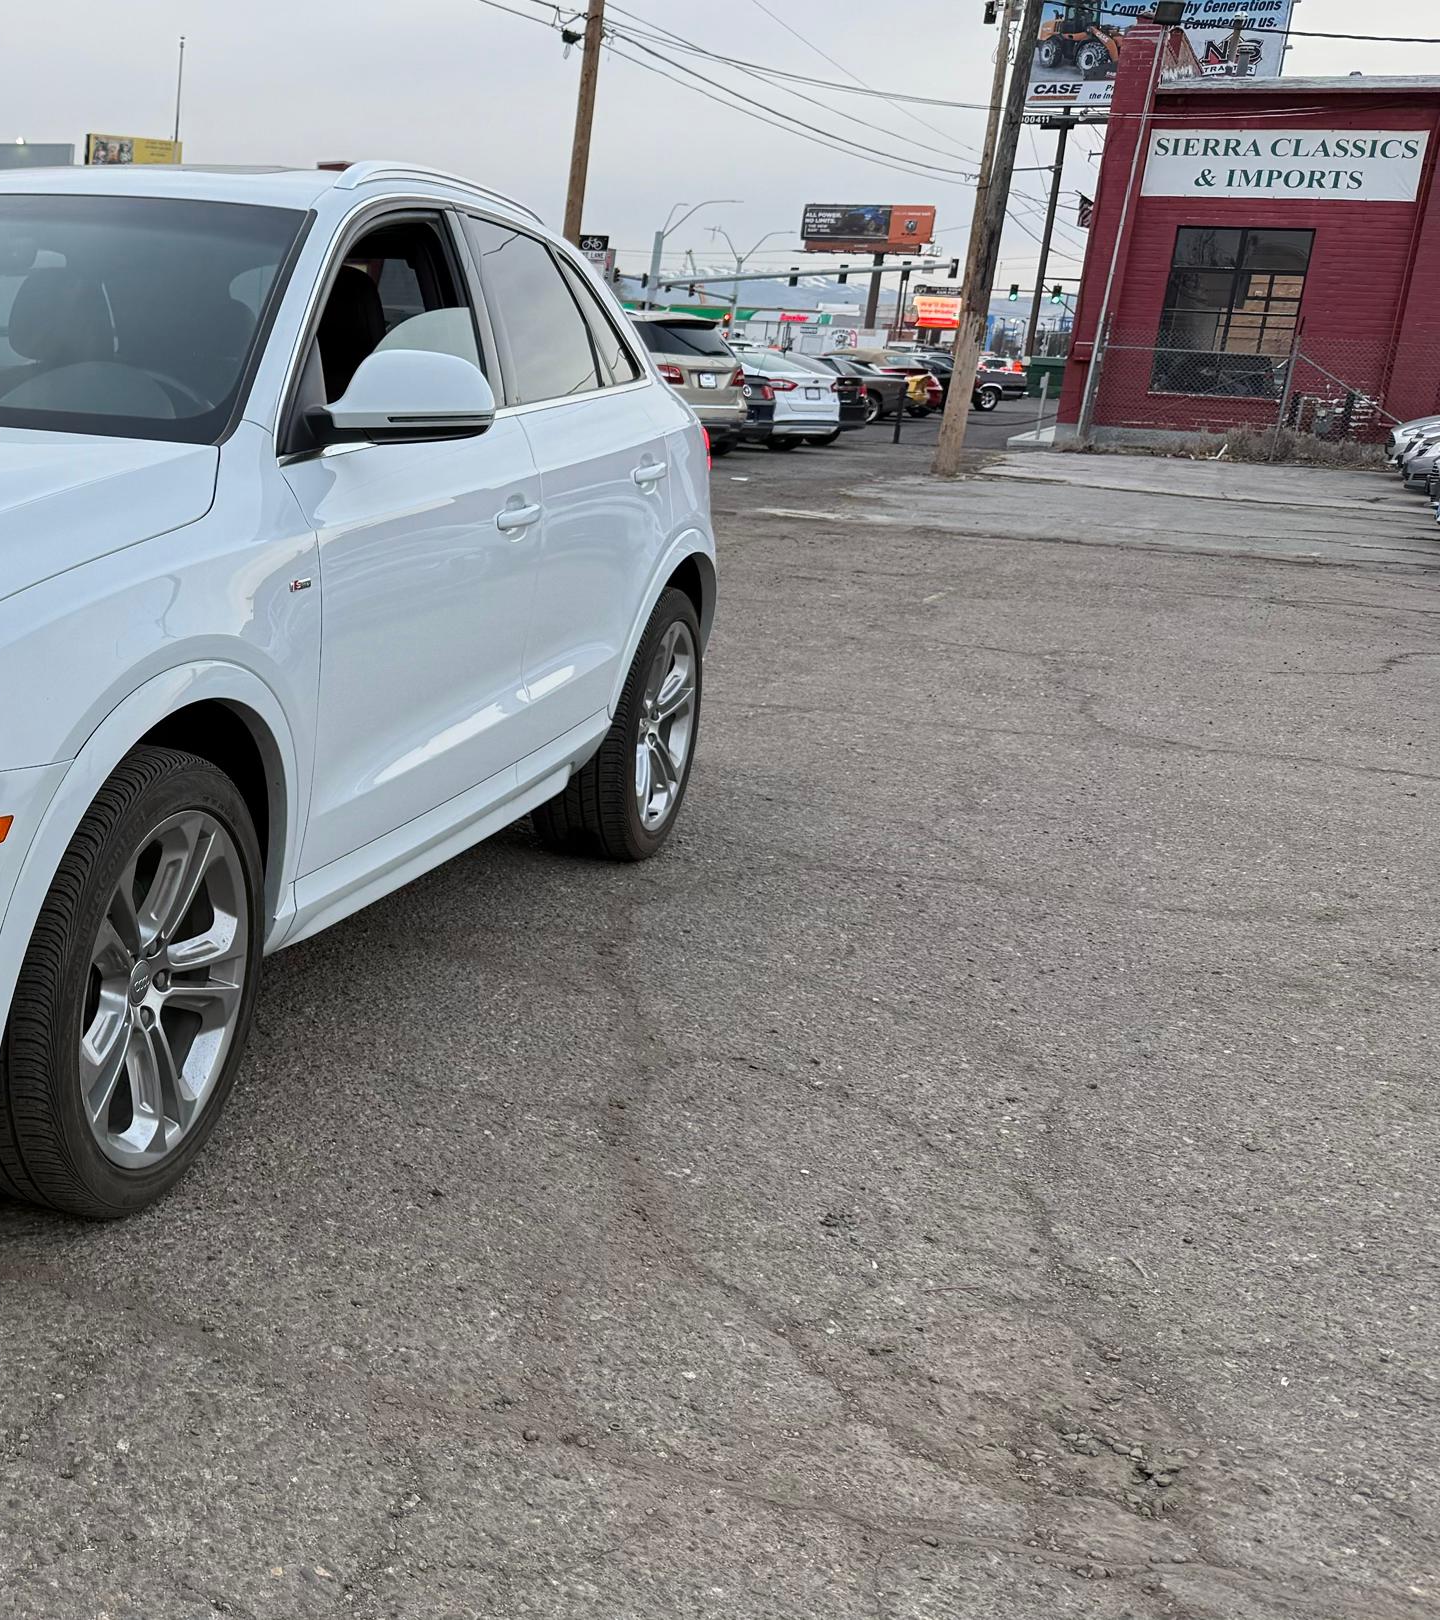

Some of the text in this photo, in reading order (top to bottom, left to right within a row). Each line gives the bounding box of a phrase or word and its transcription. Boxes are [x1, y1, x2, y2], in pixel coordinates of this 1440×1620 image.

[1112, 2, 1146, 16] Come
[1203, 0, 1282, 13] Generations
[1258, 17, 1277, 28] us.
[1034, 84, 1083, 94] CASE
[1155, 138, 1420, 159] SIERRA CLASSICS
[1194, 168, 1364, 189] & IMPORTS
